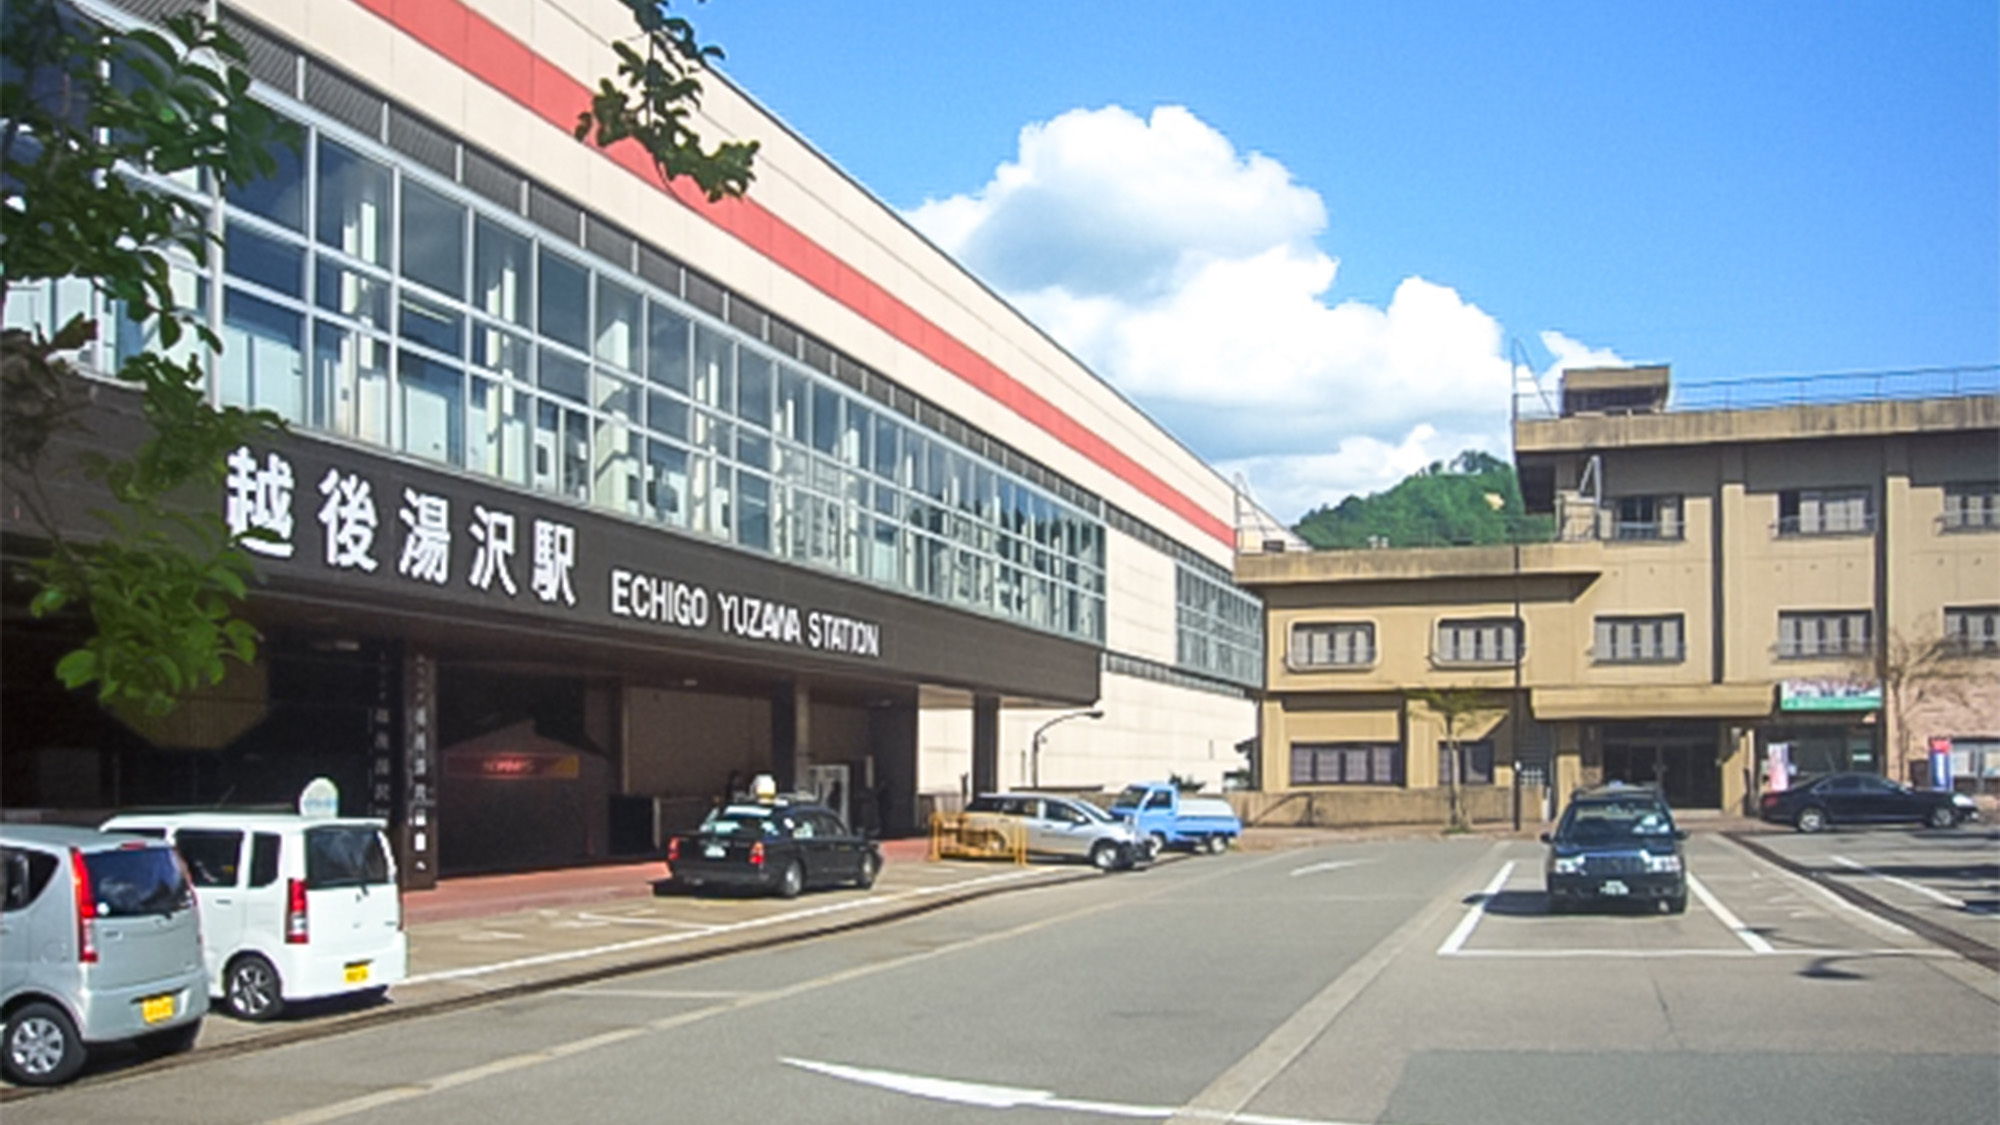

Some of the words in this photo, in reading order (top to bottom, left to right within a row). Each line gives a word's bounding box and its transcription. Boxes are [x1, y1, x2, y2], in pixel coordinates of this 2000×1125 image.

[226, 446, 576, 606] 越後湯沢駅
[611, 569, 708, 627] ECHIGO
[718, 592, 801, 643] YUZAWA
[808, 611, 880, 656] STATION
